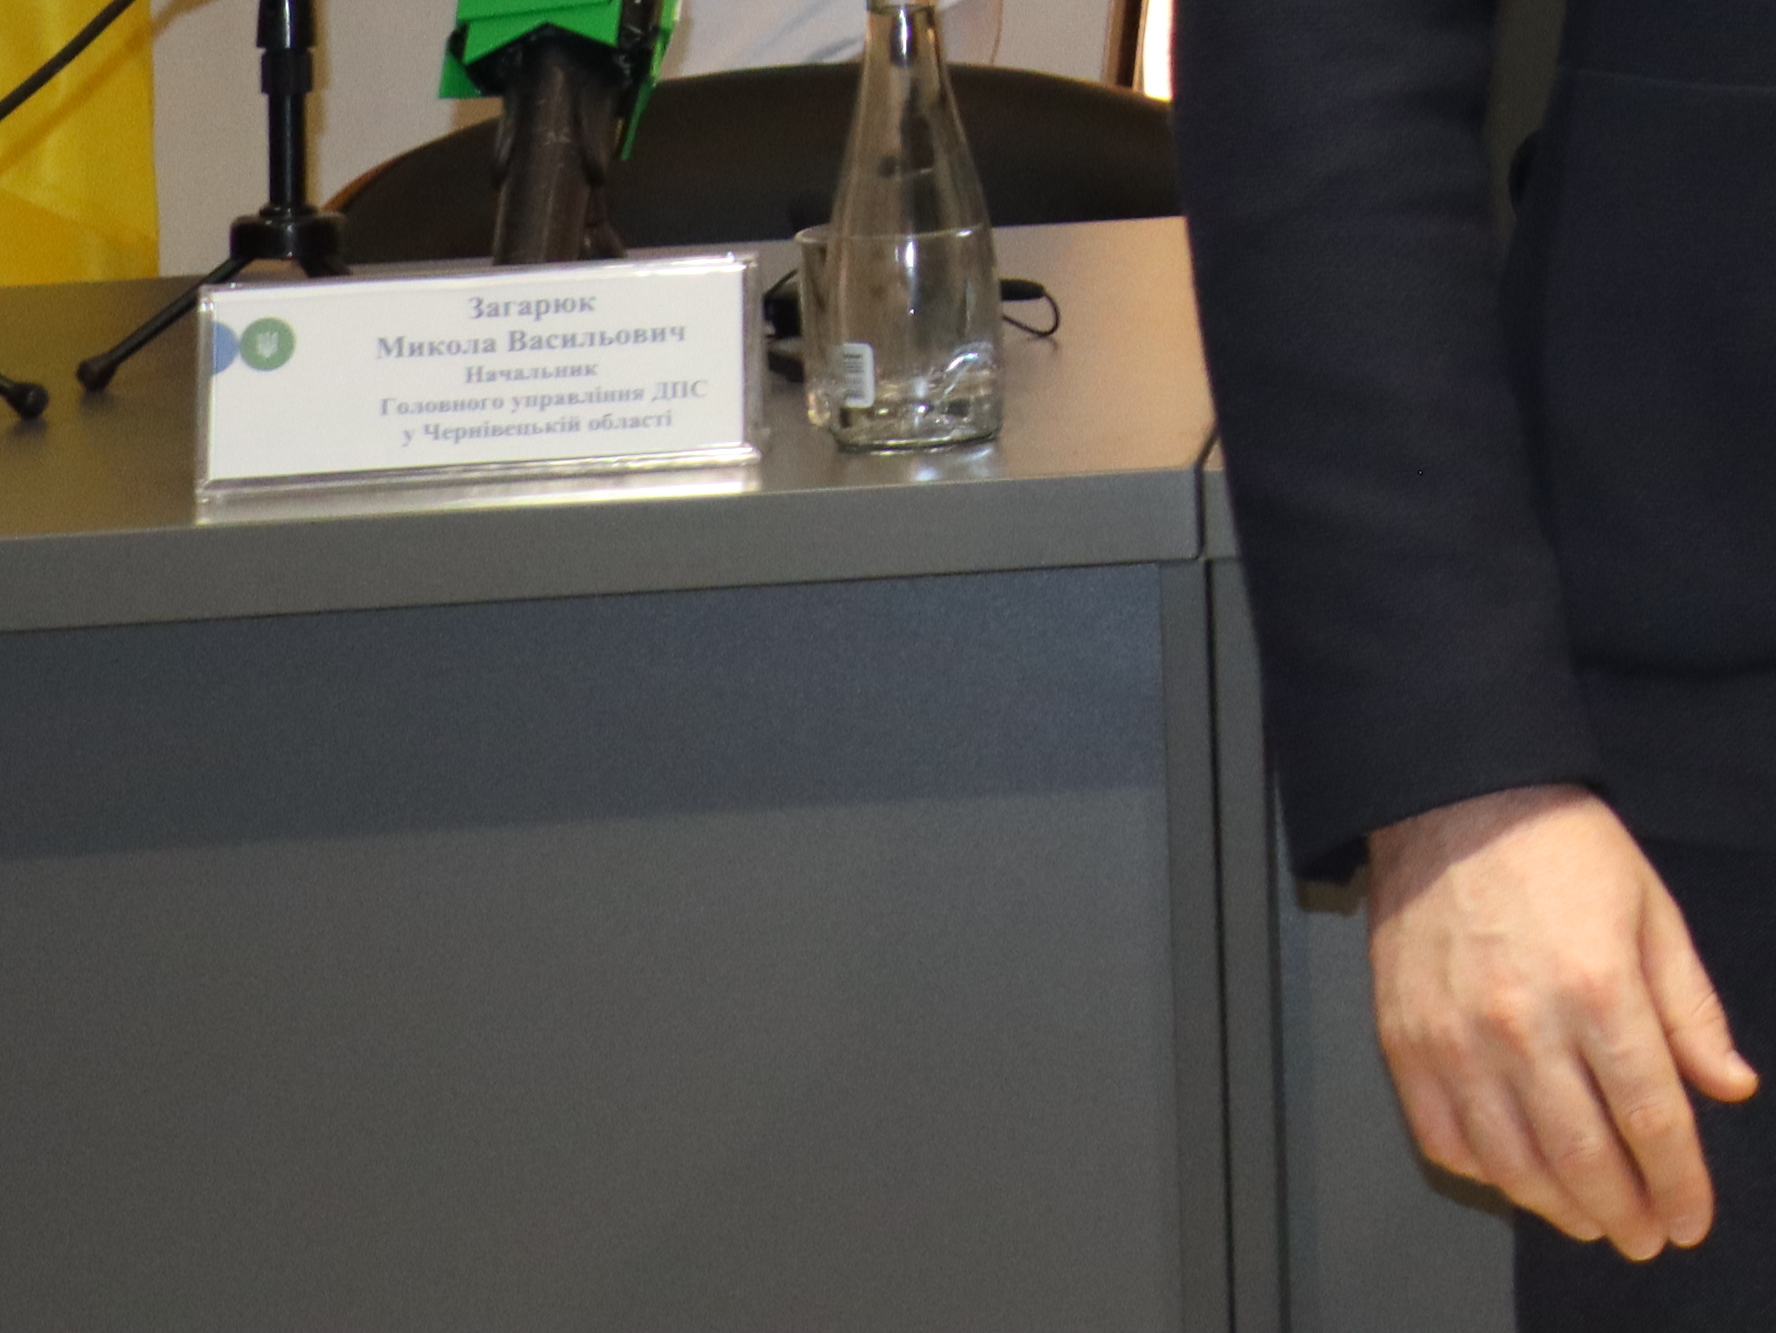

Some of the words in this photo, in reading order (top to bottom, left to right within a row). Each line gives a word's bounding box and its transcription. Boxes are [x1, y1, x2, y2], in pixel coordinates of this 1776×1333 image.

[468, 295, 597, 322] Загарюк
[375, 335, 497, 359] Микола
[507, 325, 687, 353] Васильович
[465, 362, 600, 384] Начальник
[379, 395, 505, 416] Головного
[511, 385, 645, 414] управління
[651, 379, 709, 403] ДПС
[402, 427, 415, 447] у
[422, 415, 581, 444] Чернівецькій
[588, 408, 673, 431] області
